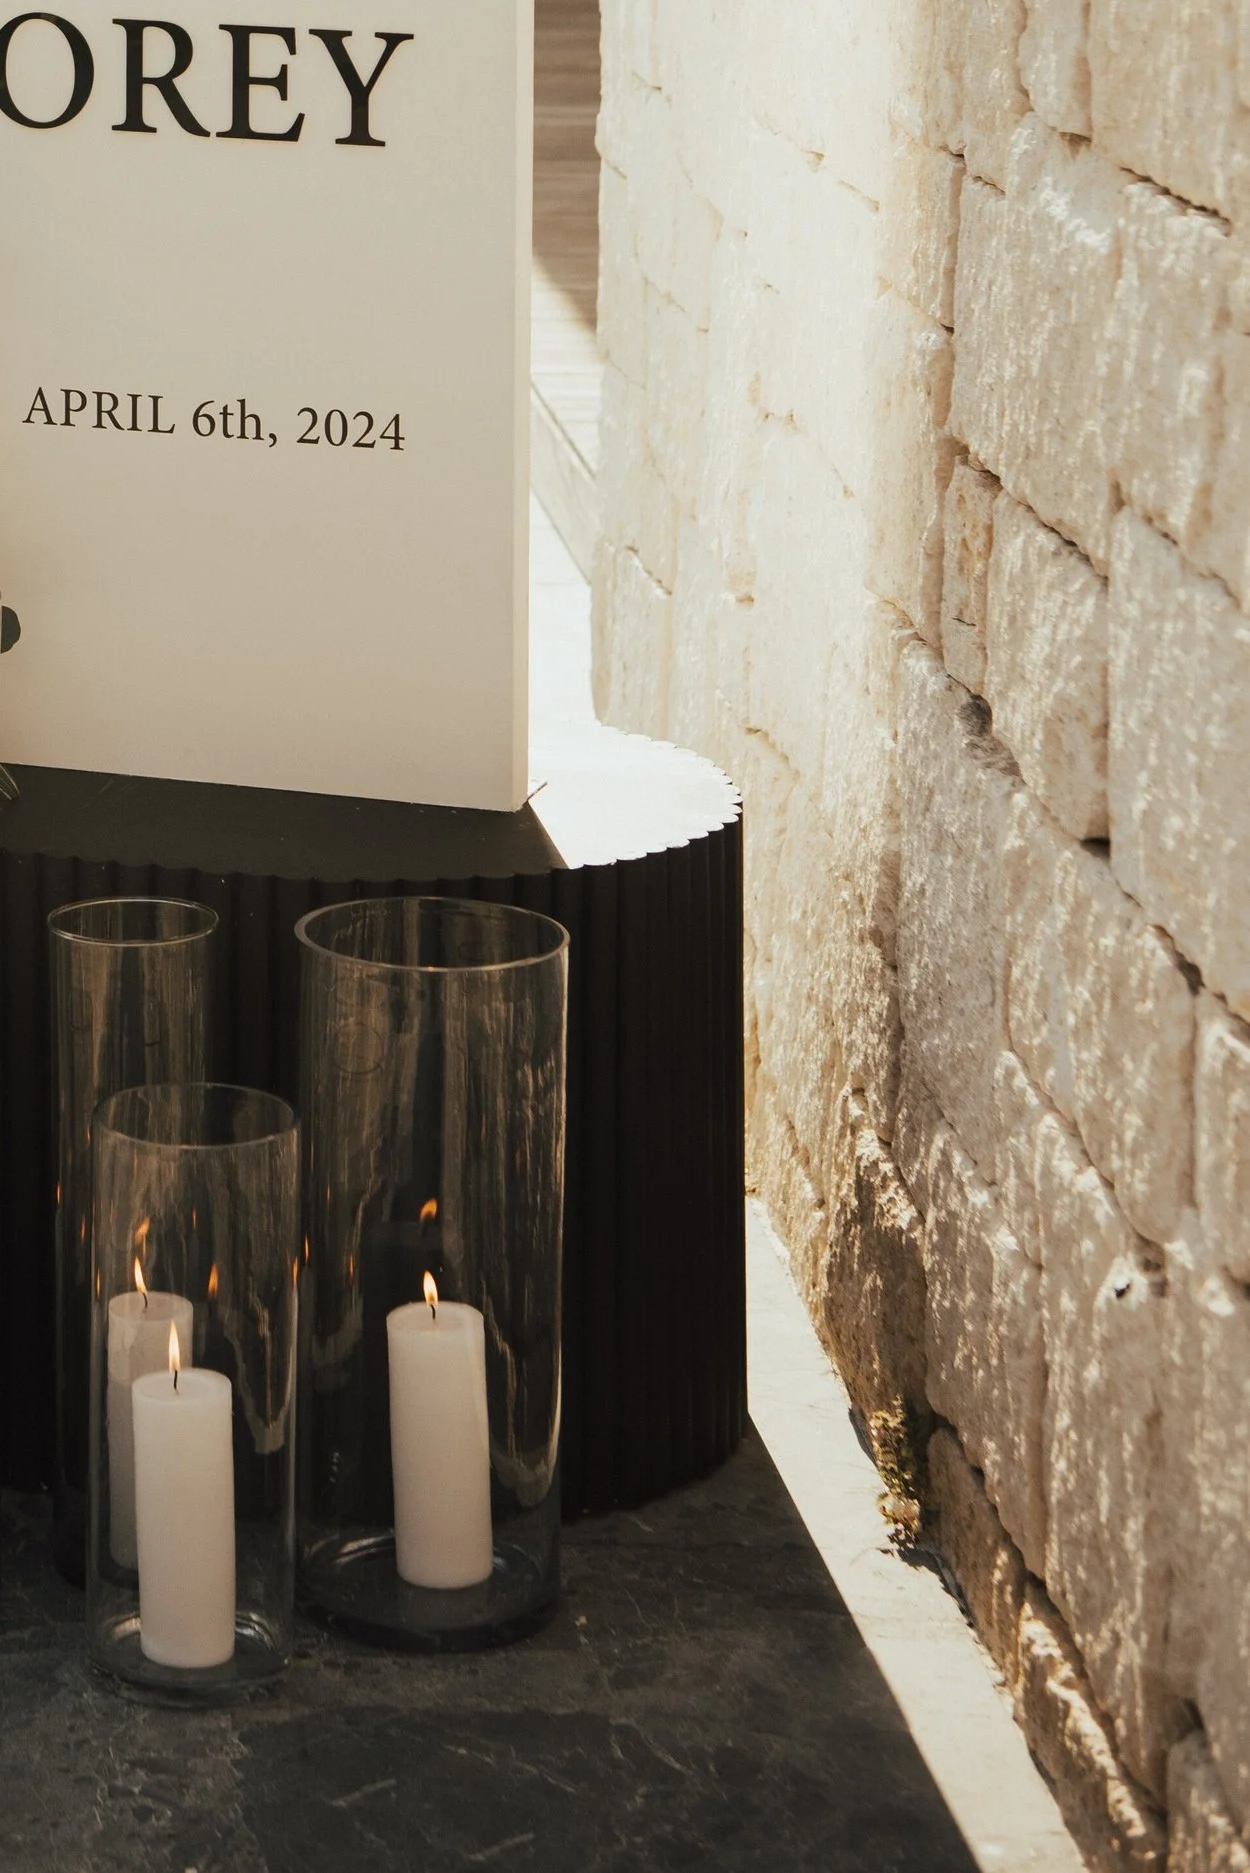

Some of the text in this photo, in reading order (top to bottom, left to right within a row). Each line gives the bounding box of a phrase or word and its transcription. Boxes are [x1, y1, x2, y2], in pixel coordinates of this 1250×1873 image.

[20, 385, 407, 452] APRIL 6th, 2024
